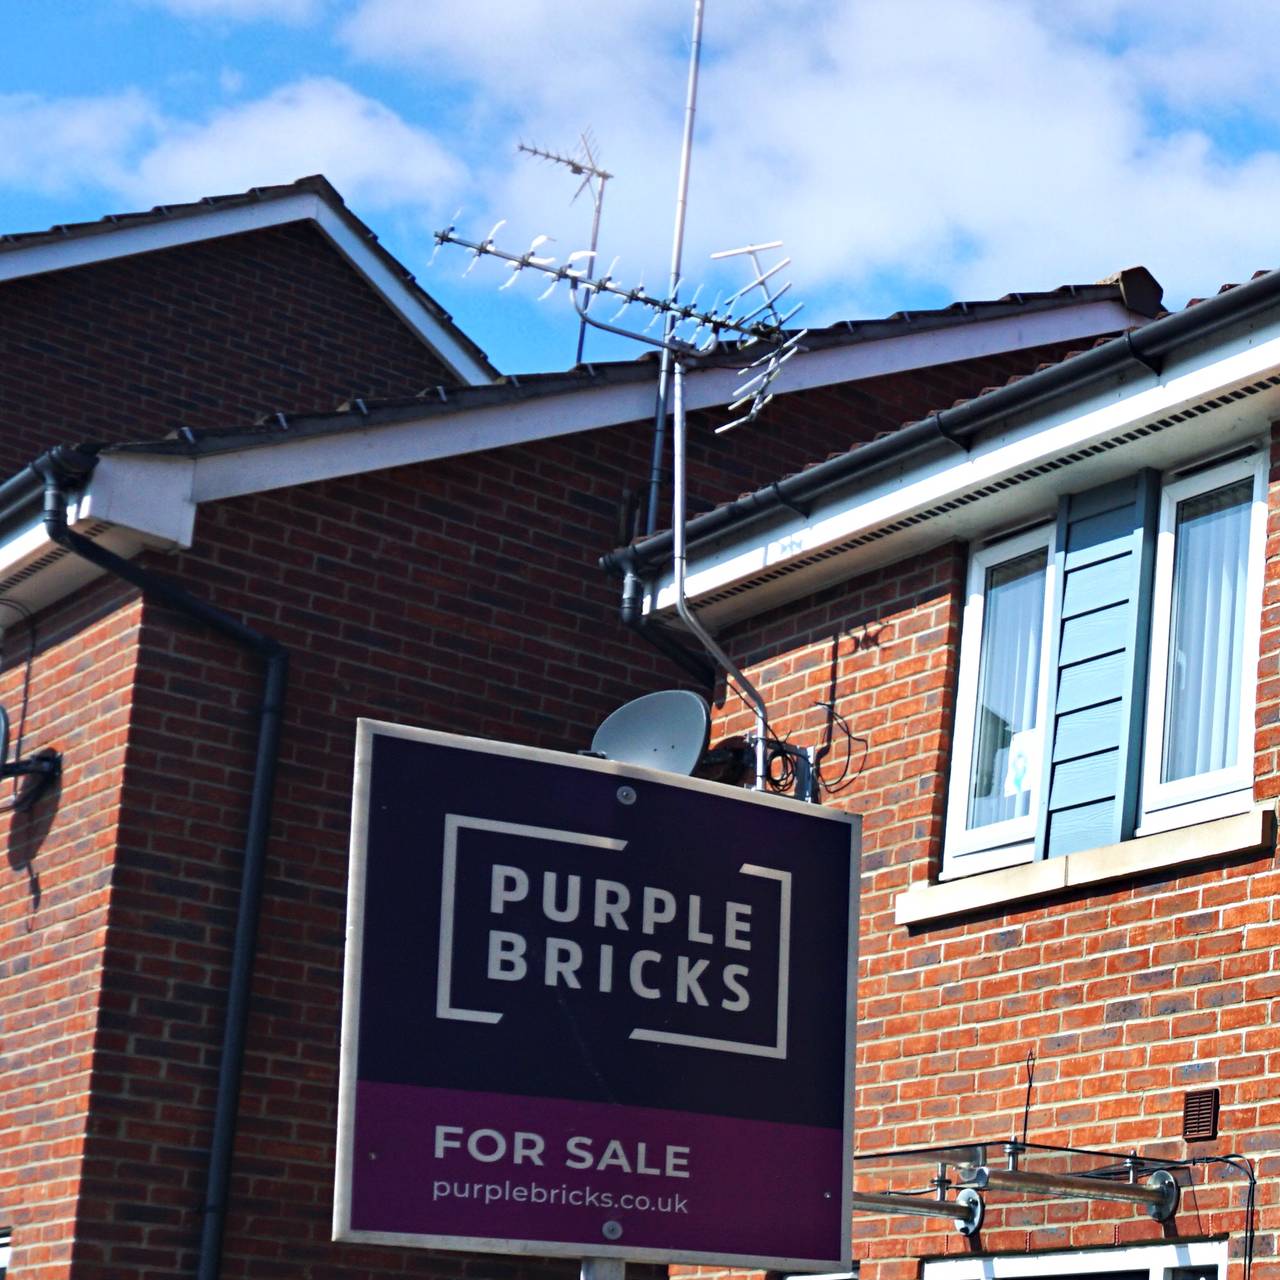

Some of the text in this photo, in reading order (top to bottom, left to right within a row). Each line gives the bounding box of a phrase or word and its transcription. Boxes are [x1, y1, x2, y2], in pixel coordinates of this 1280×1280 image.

[490, 864, 752, 951] PURPLE
[487, 930, 751, 1012] BRICKS
[434, 1125, 690, 1178] FOR SALE
[433, 1180, 688, 1214] purplebricks.co.uk
